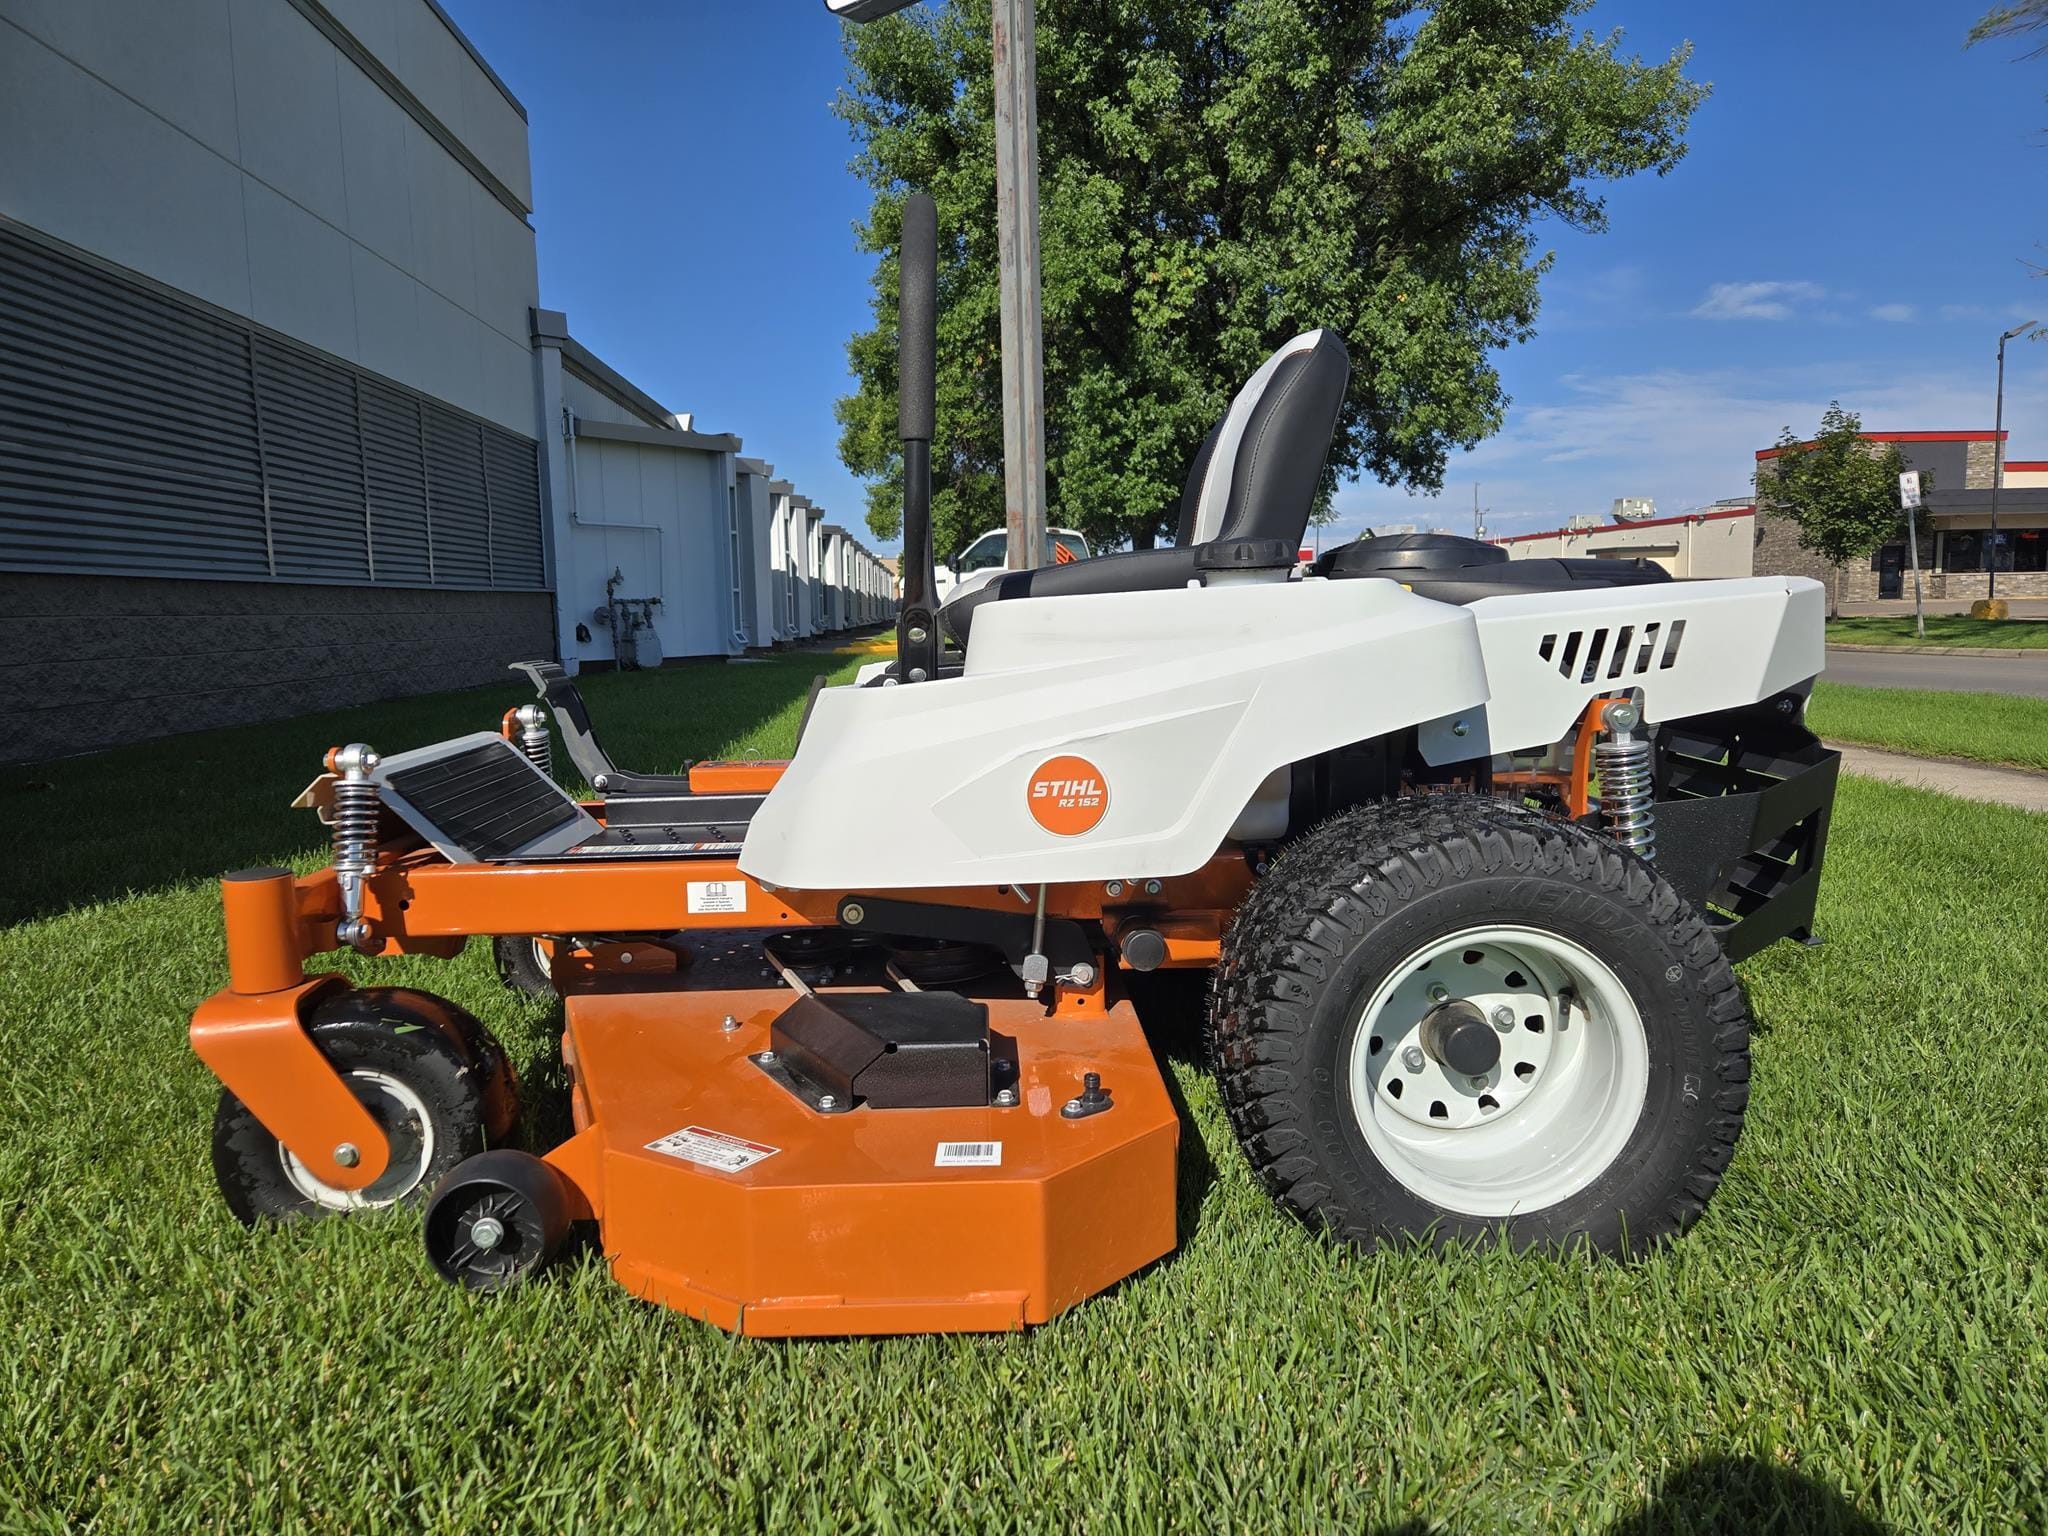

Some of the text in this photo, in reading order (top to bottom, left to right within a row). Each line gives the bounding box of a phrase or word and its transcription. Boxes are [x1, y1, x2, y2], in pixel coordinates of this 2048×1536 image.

[1032, 779, 1102, 799] STIHL
[1058, 797, 1100, 808] RZ 152
[1493, 878, 1642, 946] KENDA
